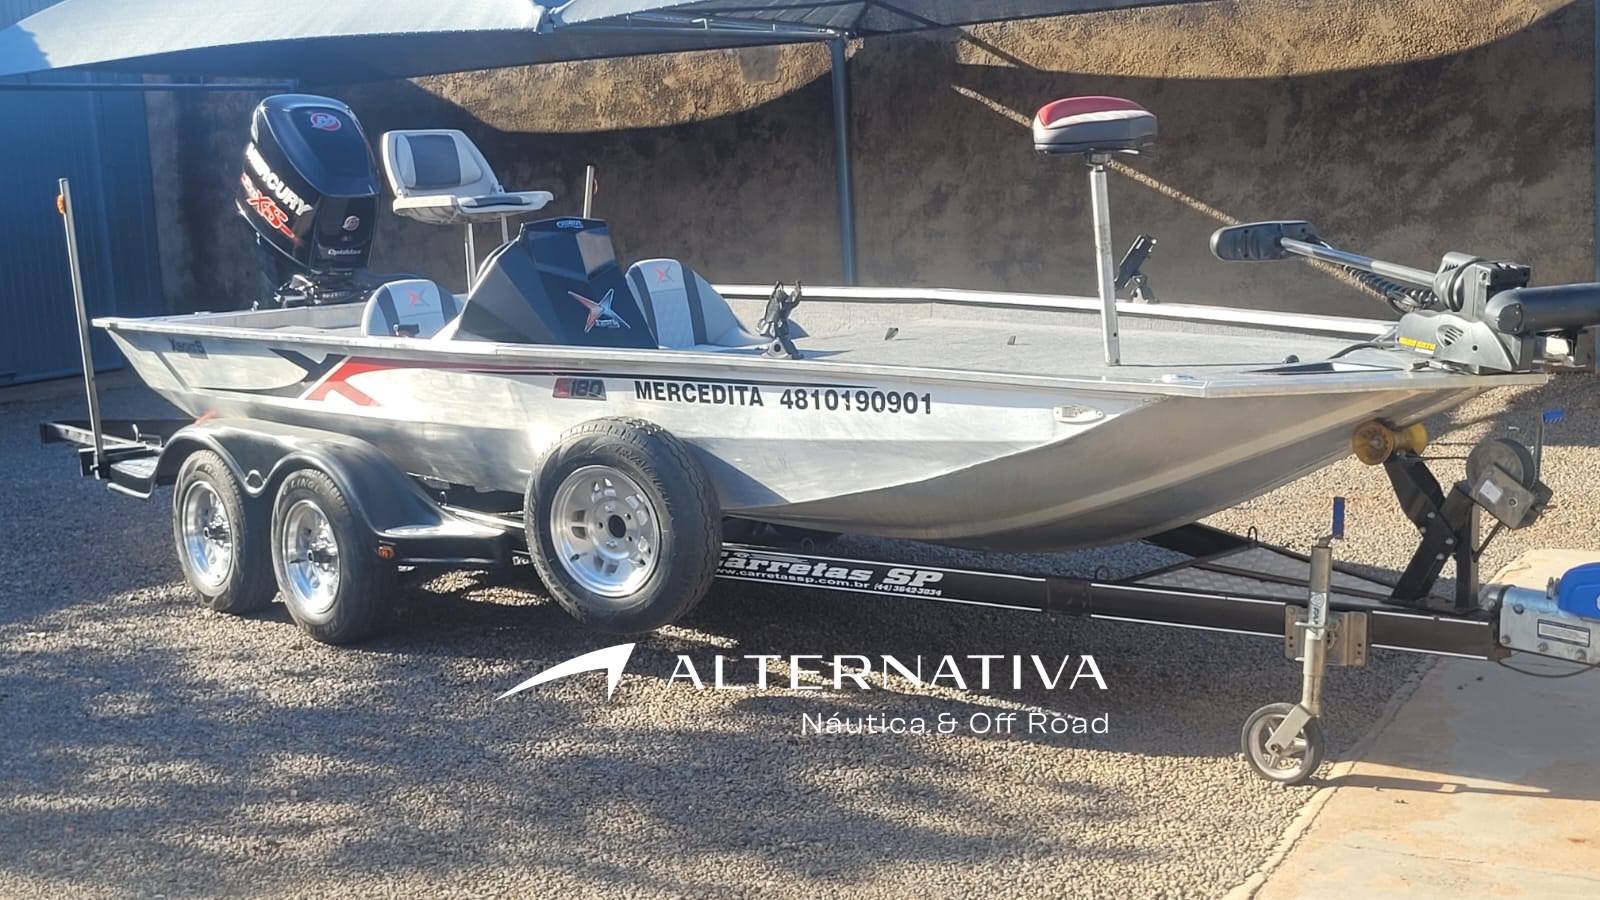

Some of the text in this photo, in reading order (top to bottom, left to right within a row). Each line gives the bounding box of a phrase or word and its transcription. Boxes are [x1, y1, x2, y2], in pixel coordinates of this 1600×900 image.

[634, 380, 932, 414] MERCEDITA 4810190901
[716, 567, 871, 589] ww.carretassp.com.br
[882, 567, 944, 588] SP
